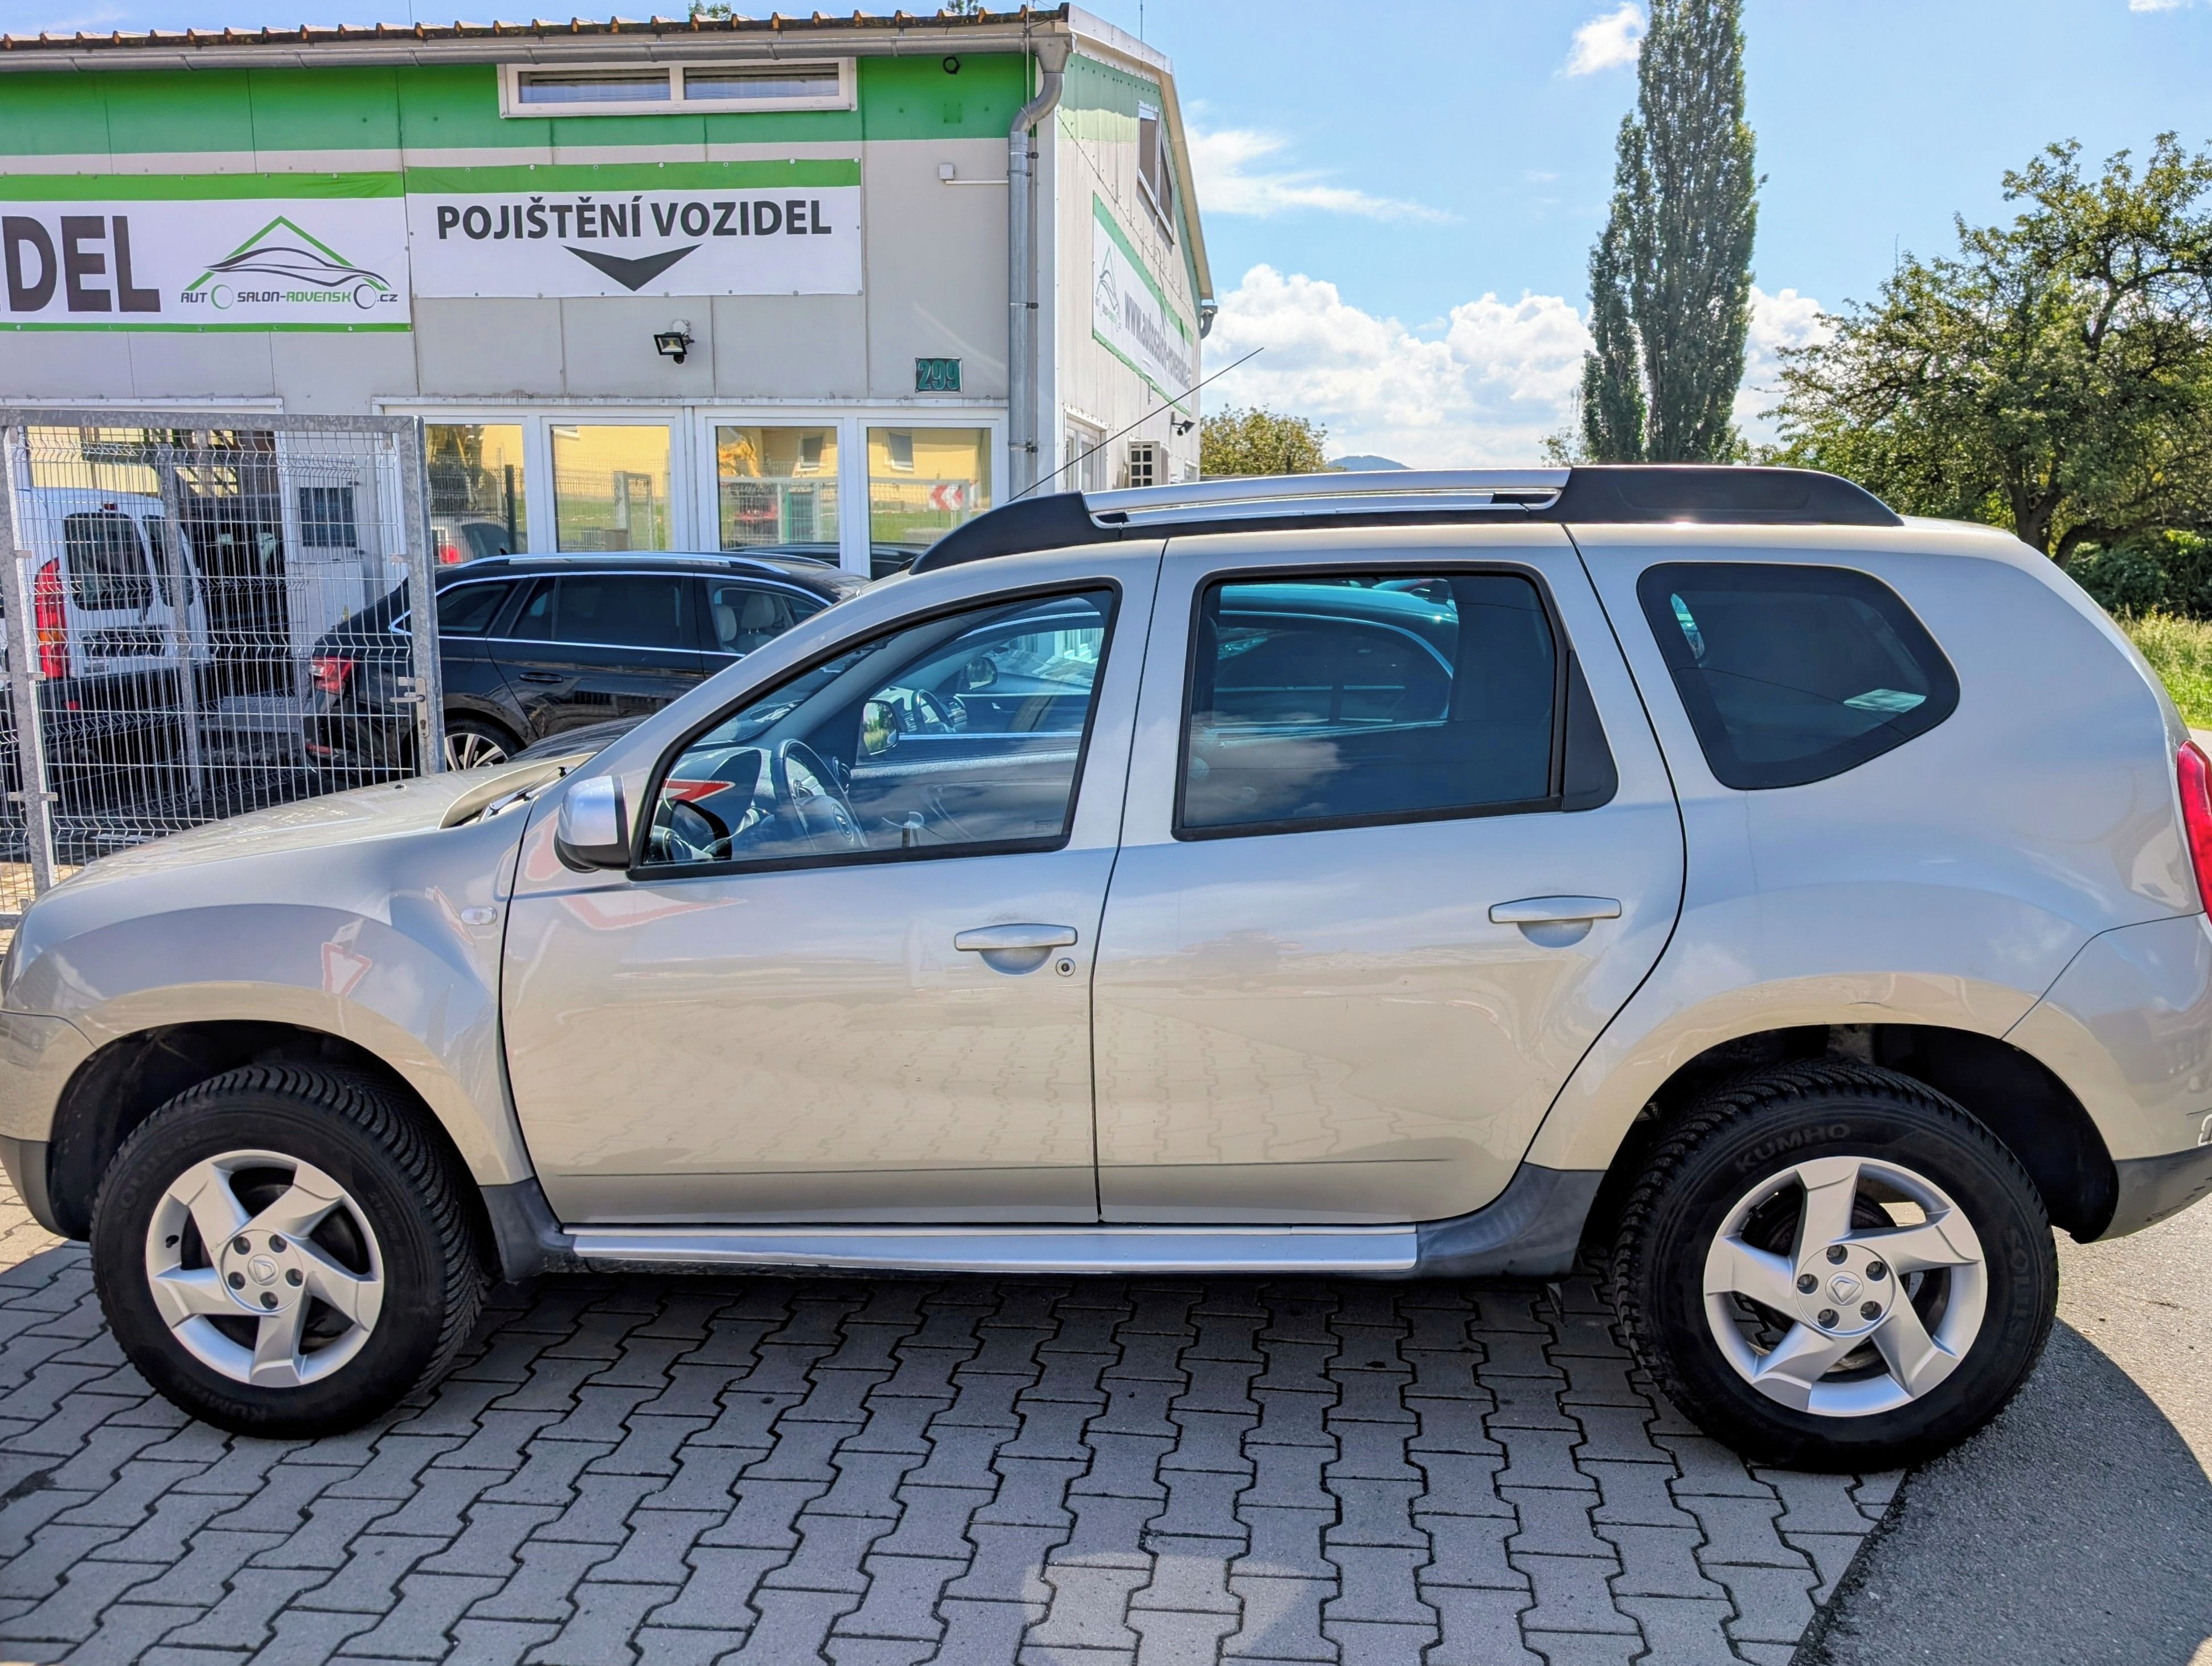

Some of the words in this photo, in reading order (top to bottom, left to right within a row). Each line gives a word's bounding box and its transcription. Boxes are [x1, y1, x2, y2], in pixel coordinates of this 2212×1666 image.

[437, 195, 644, 240] POJIŠTĚNÍ
[650, 200, 832, 237] VOZIDEL
[0, 215, 161, 313] DEL
[917, 359, 960, 390] 299
[1735, 1123, 1851, 1172] KUMHO
